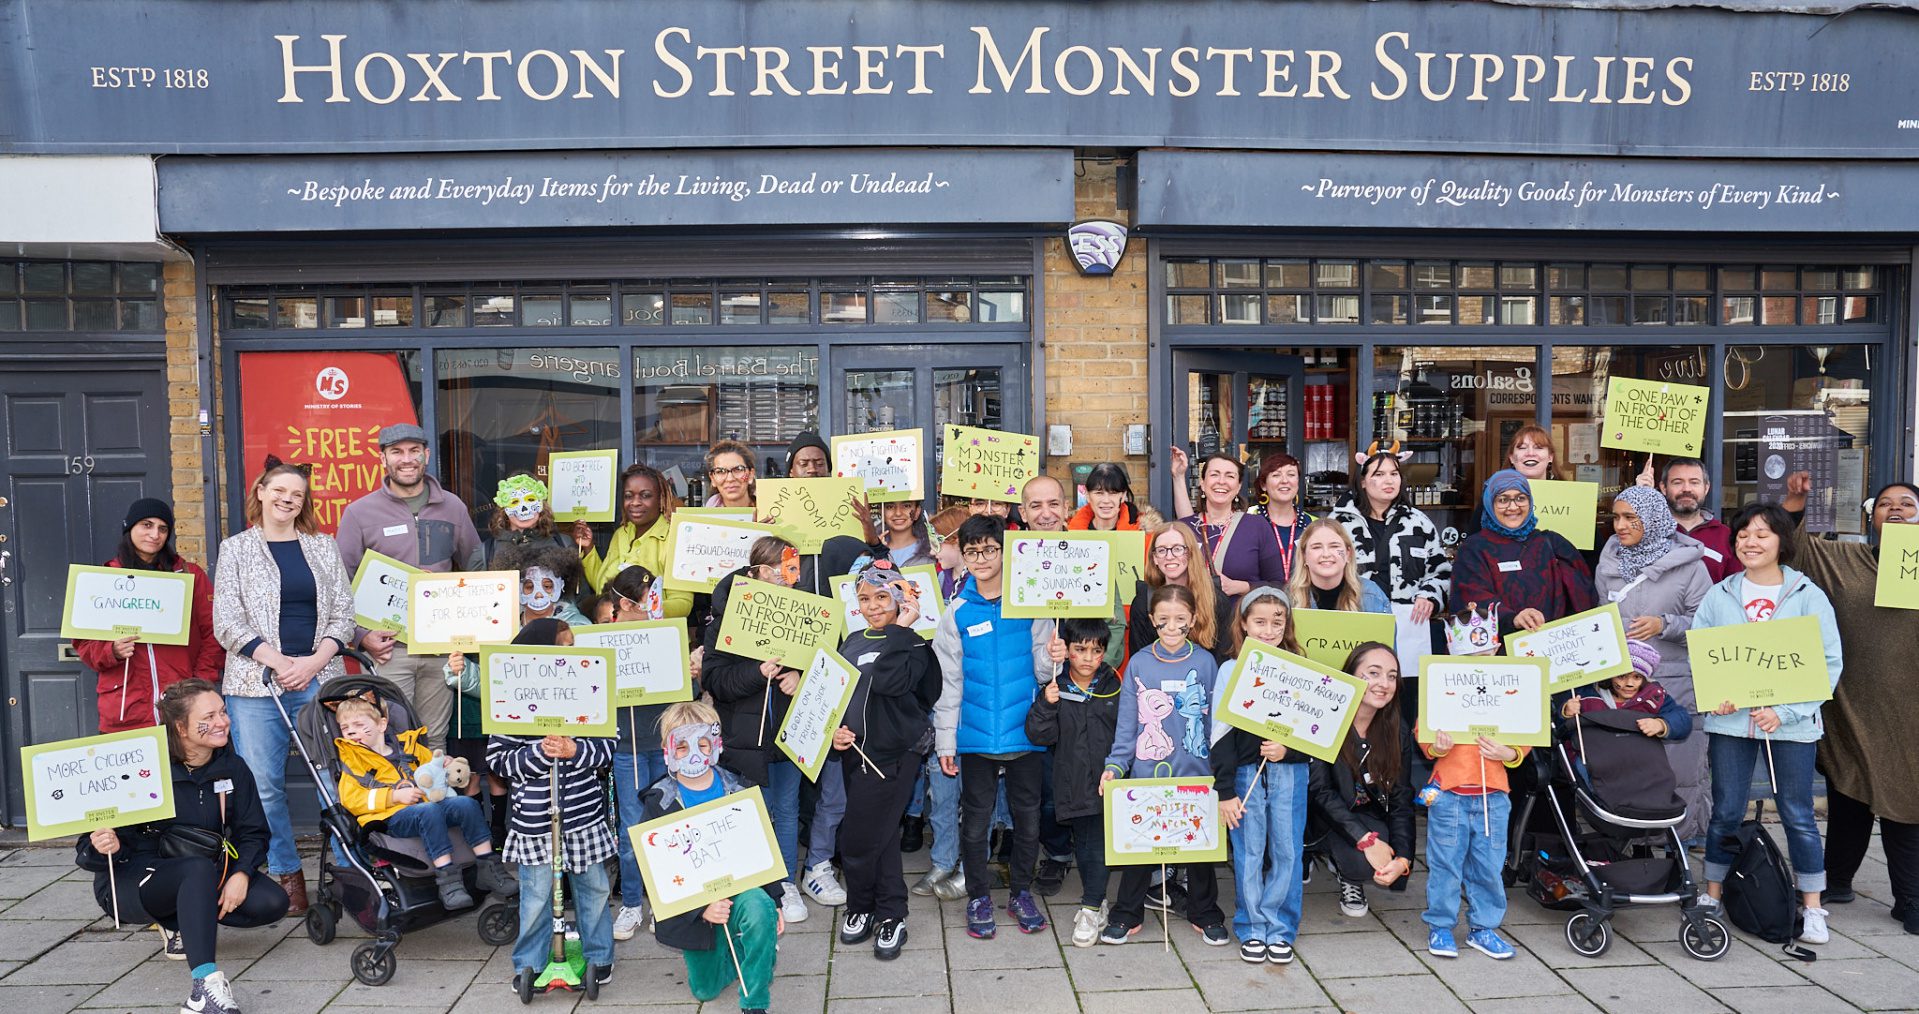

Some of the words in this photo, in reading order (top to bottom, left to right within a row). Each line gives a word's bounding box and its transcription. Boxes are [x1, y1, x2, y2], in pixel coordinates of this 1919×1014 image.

[274, 34, 625, 105] HOXTON
[652, 26, 945, 98] STREET
[968, 26, 1351, 99] MONSTER
[1370, 31, 1693, 106] SUPPLIES
[163, 68, 209, 89] 1818
[1810, 73, 1850, 92] 1818
[389, 178, 433, 200] and
[436, 177, 535, 206] Everyday
[540, 177, 597, 200] Items
[597, 175, 633, 203] for
[638, 175, 671, 196] the
[675, 176, 751, 202] Living,
[756, 173, 816, 194] Dead
[821, 180, 844, 194] or
[1411, 178, 1438, 206] of
[1437, 179, 1513, 207] Quality
[1517, 180, 1575, 201] Goods
[1575, 181, 1607, 208] for
[1609, 183, 1695, 203] Monsters
[1697, 182, 1721, 210] of
[1720, 184, 1773, 210] Every
[1078, 235, 1120, 253] ESS
[1628, 387, 1658, 404] ONE
[1660, 391, 1688, 406] PAW
[1614, 400, 1629, 414] IN
[1630, 402, 1677, 419] FRONT
[1678, 407, 1698, 422] OF
[1620, 415, 1653, 430] THE
[1654, 418, 1689, 434] OTHER
[306, 428, 363, 459] FREE
[64, 456, 95, 475] 159
[769, 486, 792, 518] OMP
[794, 486, 827, 529] STOMP
[1054, 564, 1068, 575] ON
[114, 577, 136, 592] GO
[1042, 576, 1082, 590] SUNDAYS
[751, 591, 787, 611] ONE
[790, 598, 822, 617] PAW
[735, 601, 753, 615] IN
[755, 606, 805, 631] FRONT
[809, 619, 832, 635] OF
[740, 617, 767, 636] THE
[599, 633, 650, 648] FREEDOM
[618, 649, 632, 660] OF
[1708, 645, 1806, 670] SLITHER
[503, 662, 530, 679] PUT
[538, 663, 558, 679] ON
[567, 664, 577, 678] A
[1444, 673, 1488, 687] HANDLE
[1491, 674, 1519, 687] WITH
[514, 687, 549, 700] GRAVE
[552, 687, 578, 700] FACE
[1279, 671, 1314, 692] GHOSTS
[1313, 684, 1347, 705] AROUND
[1262, 688, 1292, 708] COMES
[1293, 700, 1324, 719] AROUND
[1461, 694, 1500, 708] SCARE
[47, 758, 87, 781] MORE
[94, 748, 144, 771] CYCLOPES
[79, 775, 117, 796] LANES
[706, 813, 737, 836] THE
[689, 839, 723, 869] BAT
